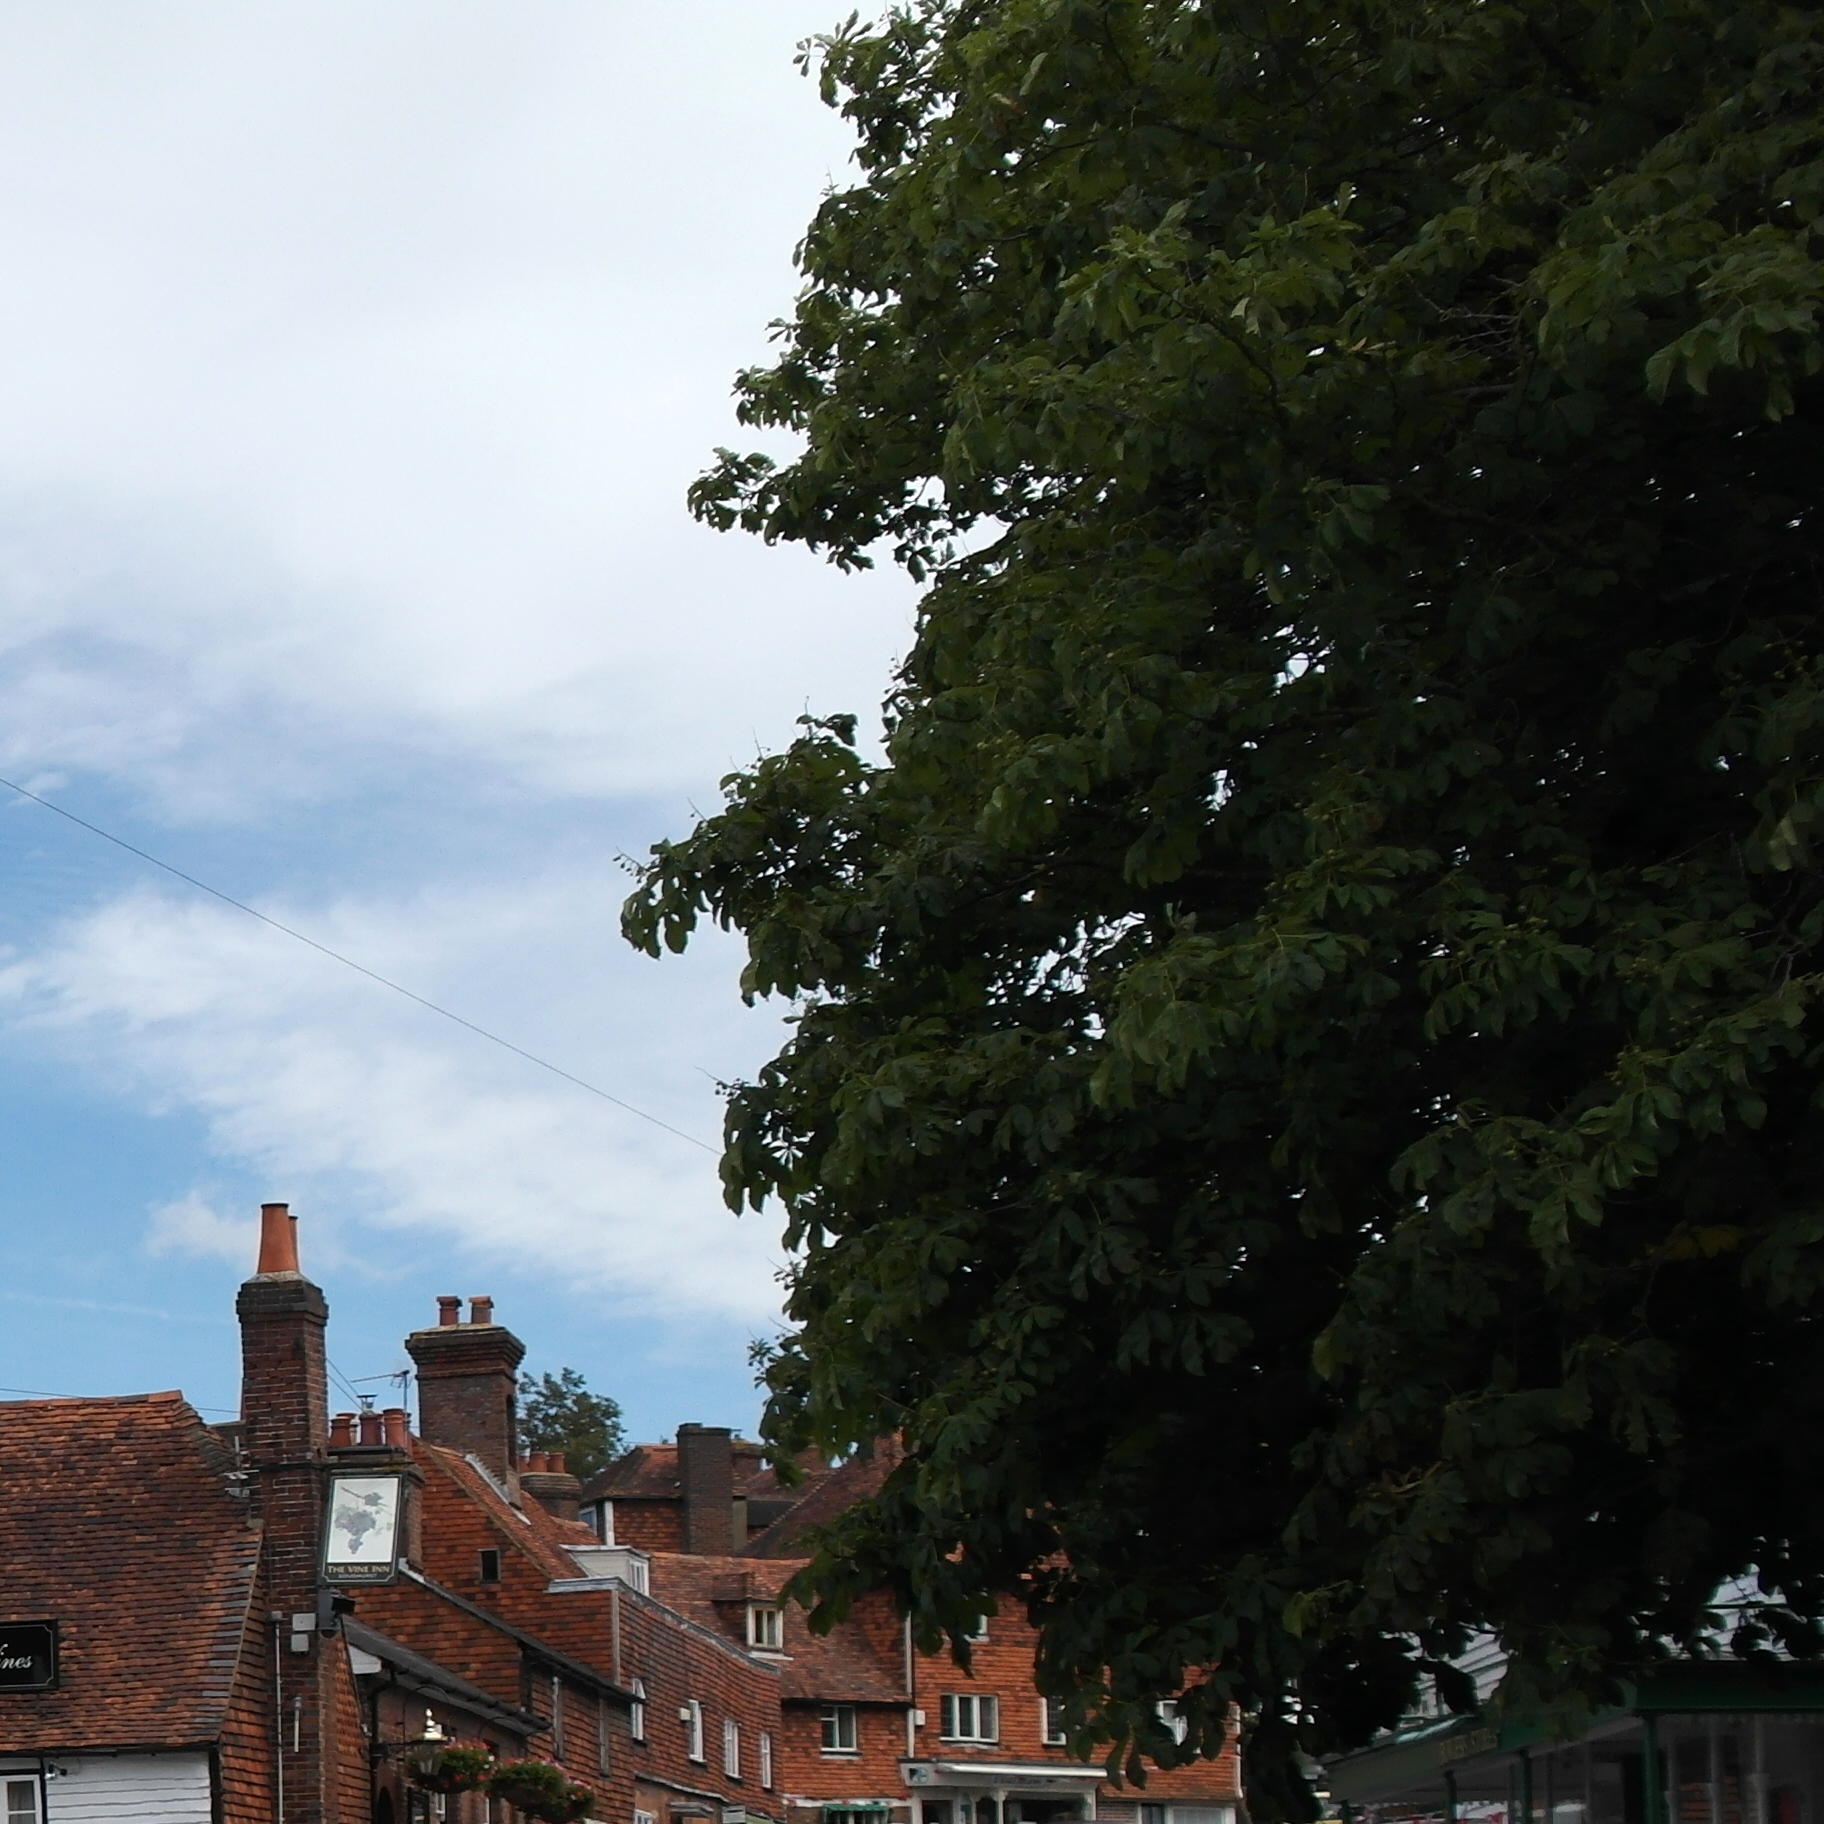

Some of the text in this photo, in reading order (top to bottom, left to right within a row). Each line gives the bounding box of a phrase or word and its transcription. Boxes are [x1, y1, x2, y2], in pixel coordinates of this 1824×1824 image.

[328, 1565, 390, 1574] THE VINE INN
